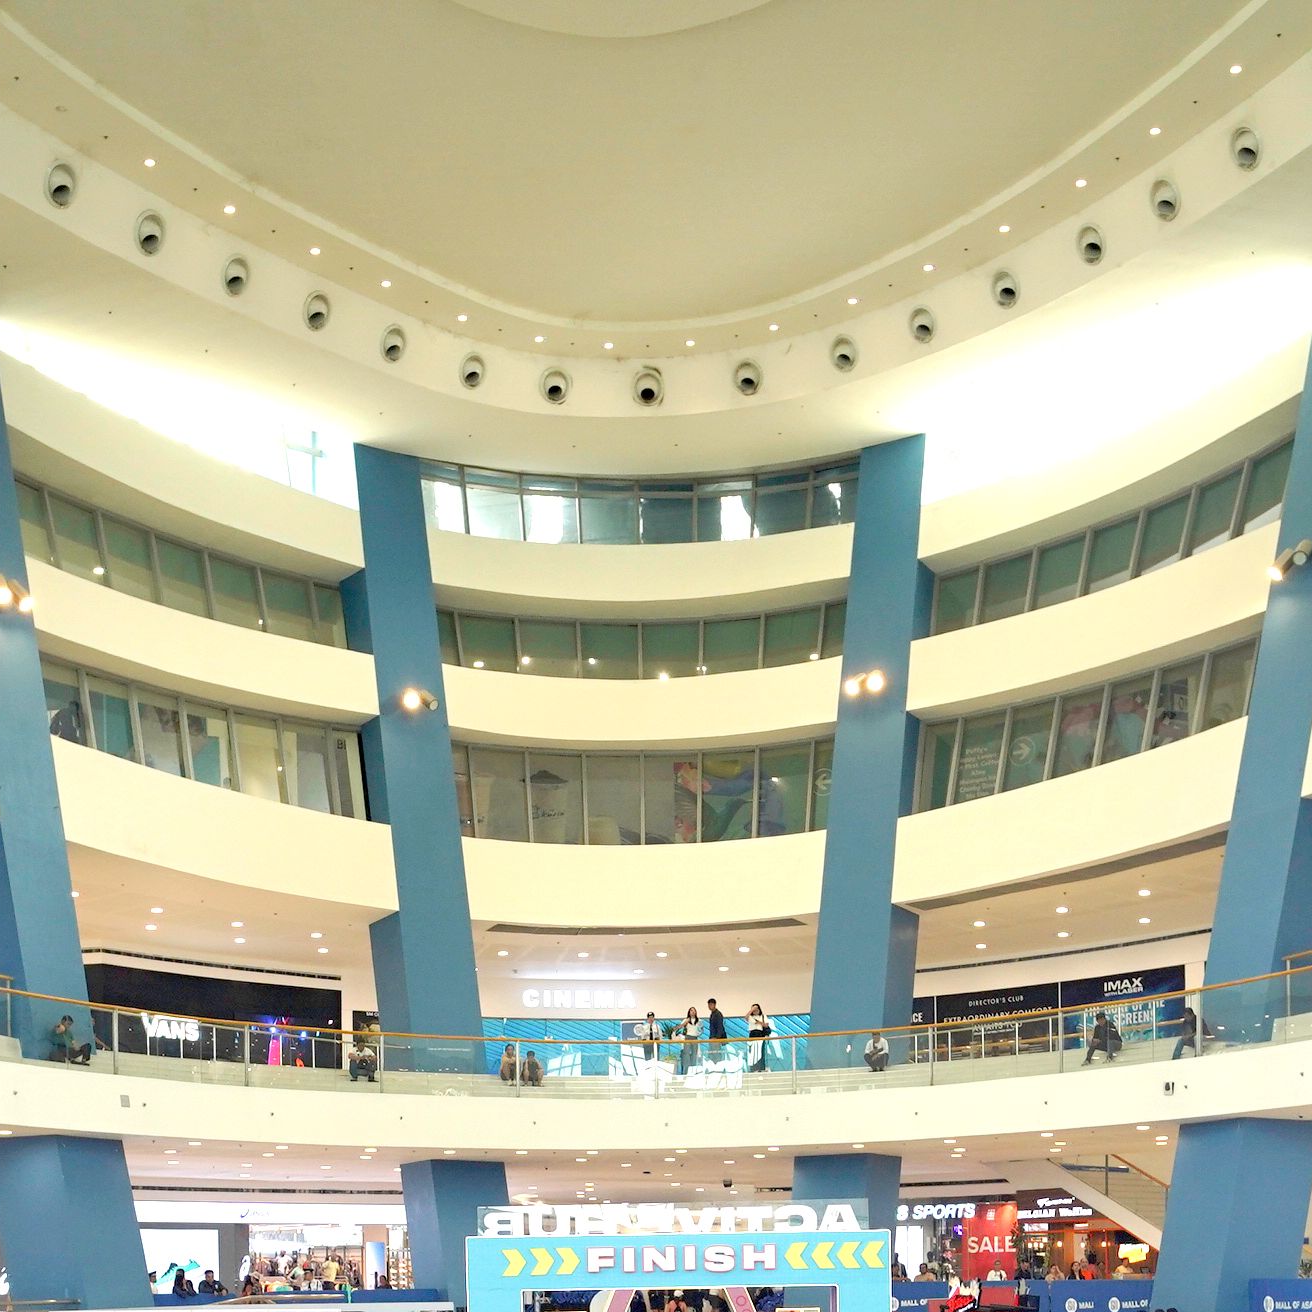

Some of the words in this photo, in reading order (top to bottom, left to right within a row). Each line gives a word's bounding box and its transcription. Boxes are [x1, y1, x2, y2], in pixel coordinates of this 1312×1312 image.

[1104, 977, 1143, 992] IMAX
[1117, 986, 1144, 995] LASER
[522, 989, 637, 1009] CINEMA
[1008, 995, 1024, 1003] CLUB
[142, 1013, 199, 1041] VANS
[912, 1202, 976, 1220] SPORTS
[968, 1236, 1017, 1253] SALE
[586, 1243, 778, 1274] FINISH
